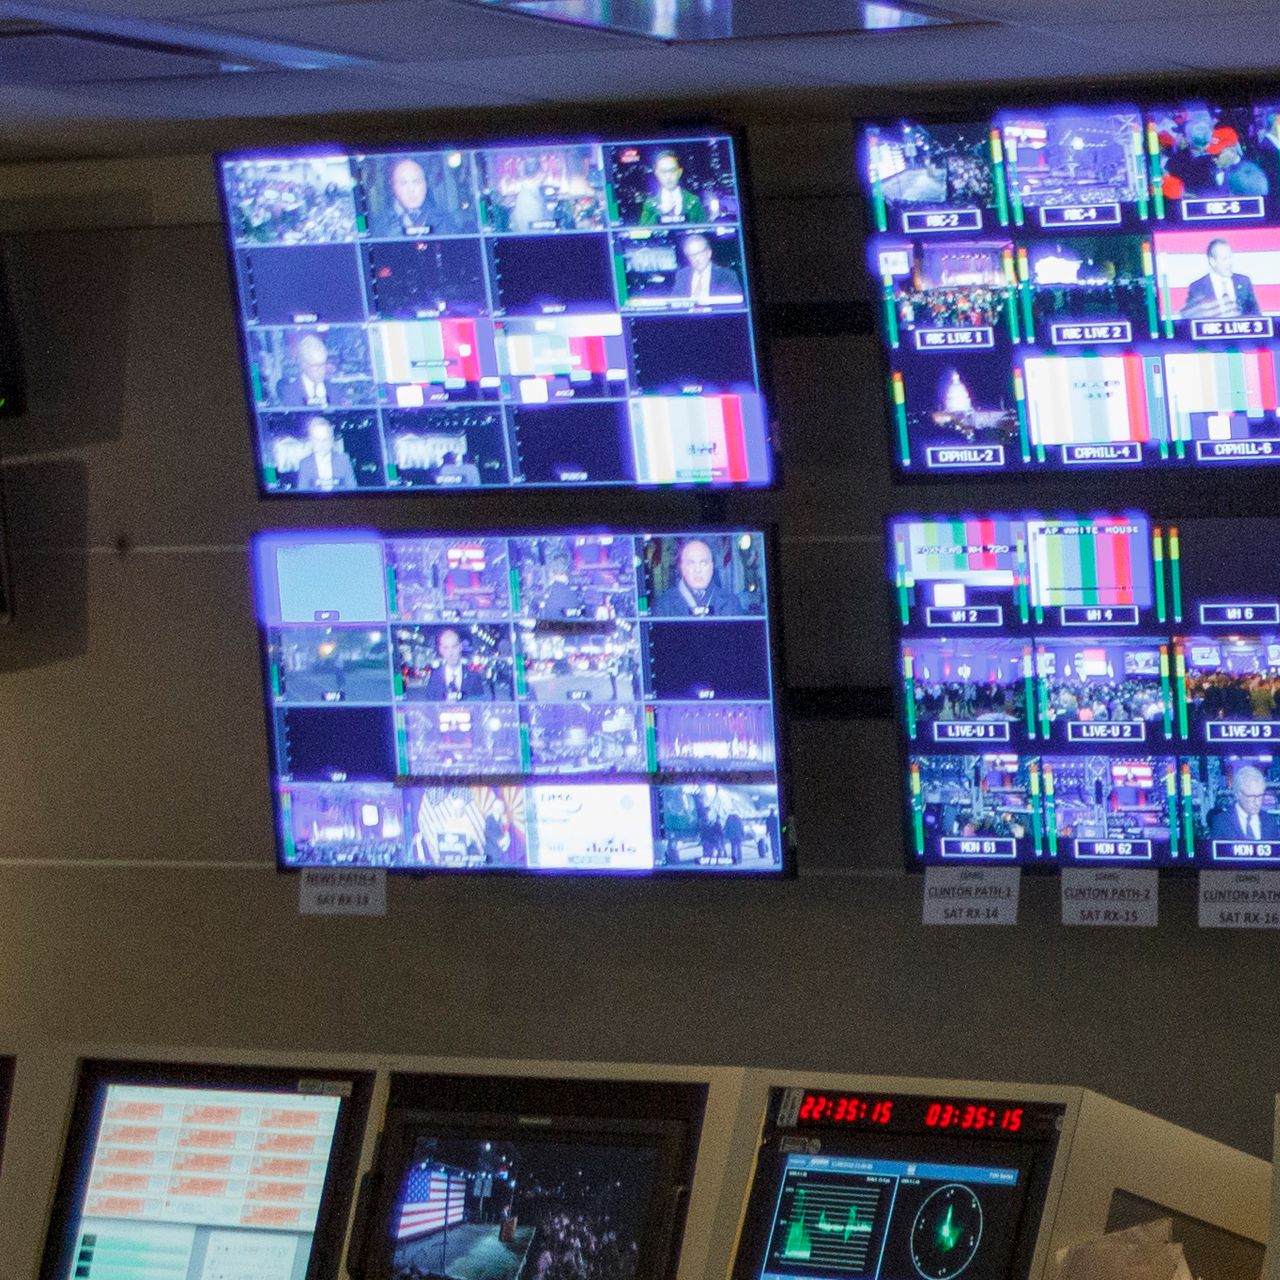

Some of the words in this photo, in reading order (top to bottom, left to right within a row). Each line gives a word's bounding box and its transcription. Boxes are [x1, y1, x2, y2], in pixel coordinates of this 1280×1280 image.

[1206, 201, 1240, 214] ABC-6
[927, 214, 958, 226] ABC-2
[1064, 208, 1096, 220] ABC-4
[1074, 446, 1130, 459] CAPHILL-4
[1214, 442, 1272, 455] CAPHILL-6
[938, 449, 993, 462] CAPHILL-2
[1044, 527, 1058, 535] AP
[1063, 526, 1098, 535] WHITE
[1105, 526, 1138, 534] HOUSE
[948, 724, 985, 737] LIVE-U
[989, 725, 994, 737] 1
[1082, 725, 1120, 737] LIVE-U
[1123, 725, 1131, 737] 2
[1221, 725, 1260, 737] LIVE-U
[1263, 725, 1271, 737] 3
[961, 841, 980, 852] MON
[983, 841, 996, 853] 61
[1094, 842, 1115, 854] MON
[1117, 843, 1132, 854] 62
[1233, 844, 1254, 856] MON
[1257, 844, 1271, 856] 63
[799, 1097, 893, 1124] 22:35:15
[925, 1103, 1023, 1131] 03:35:15
